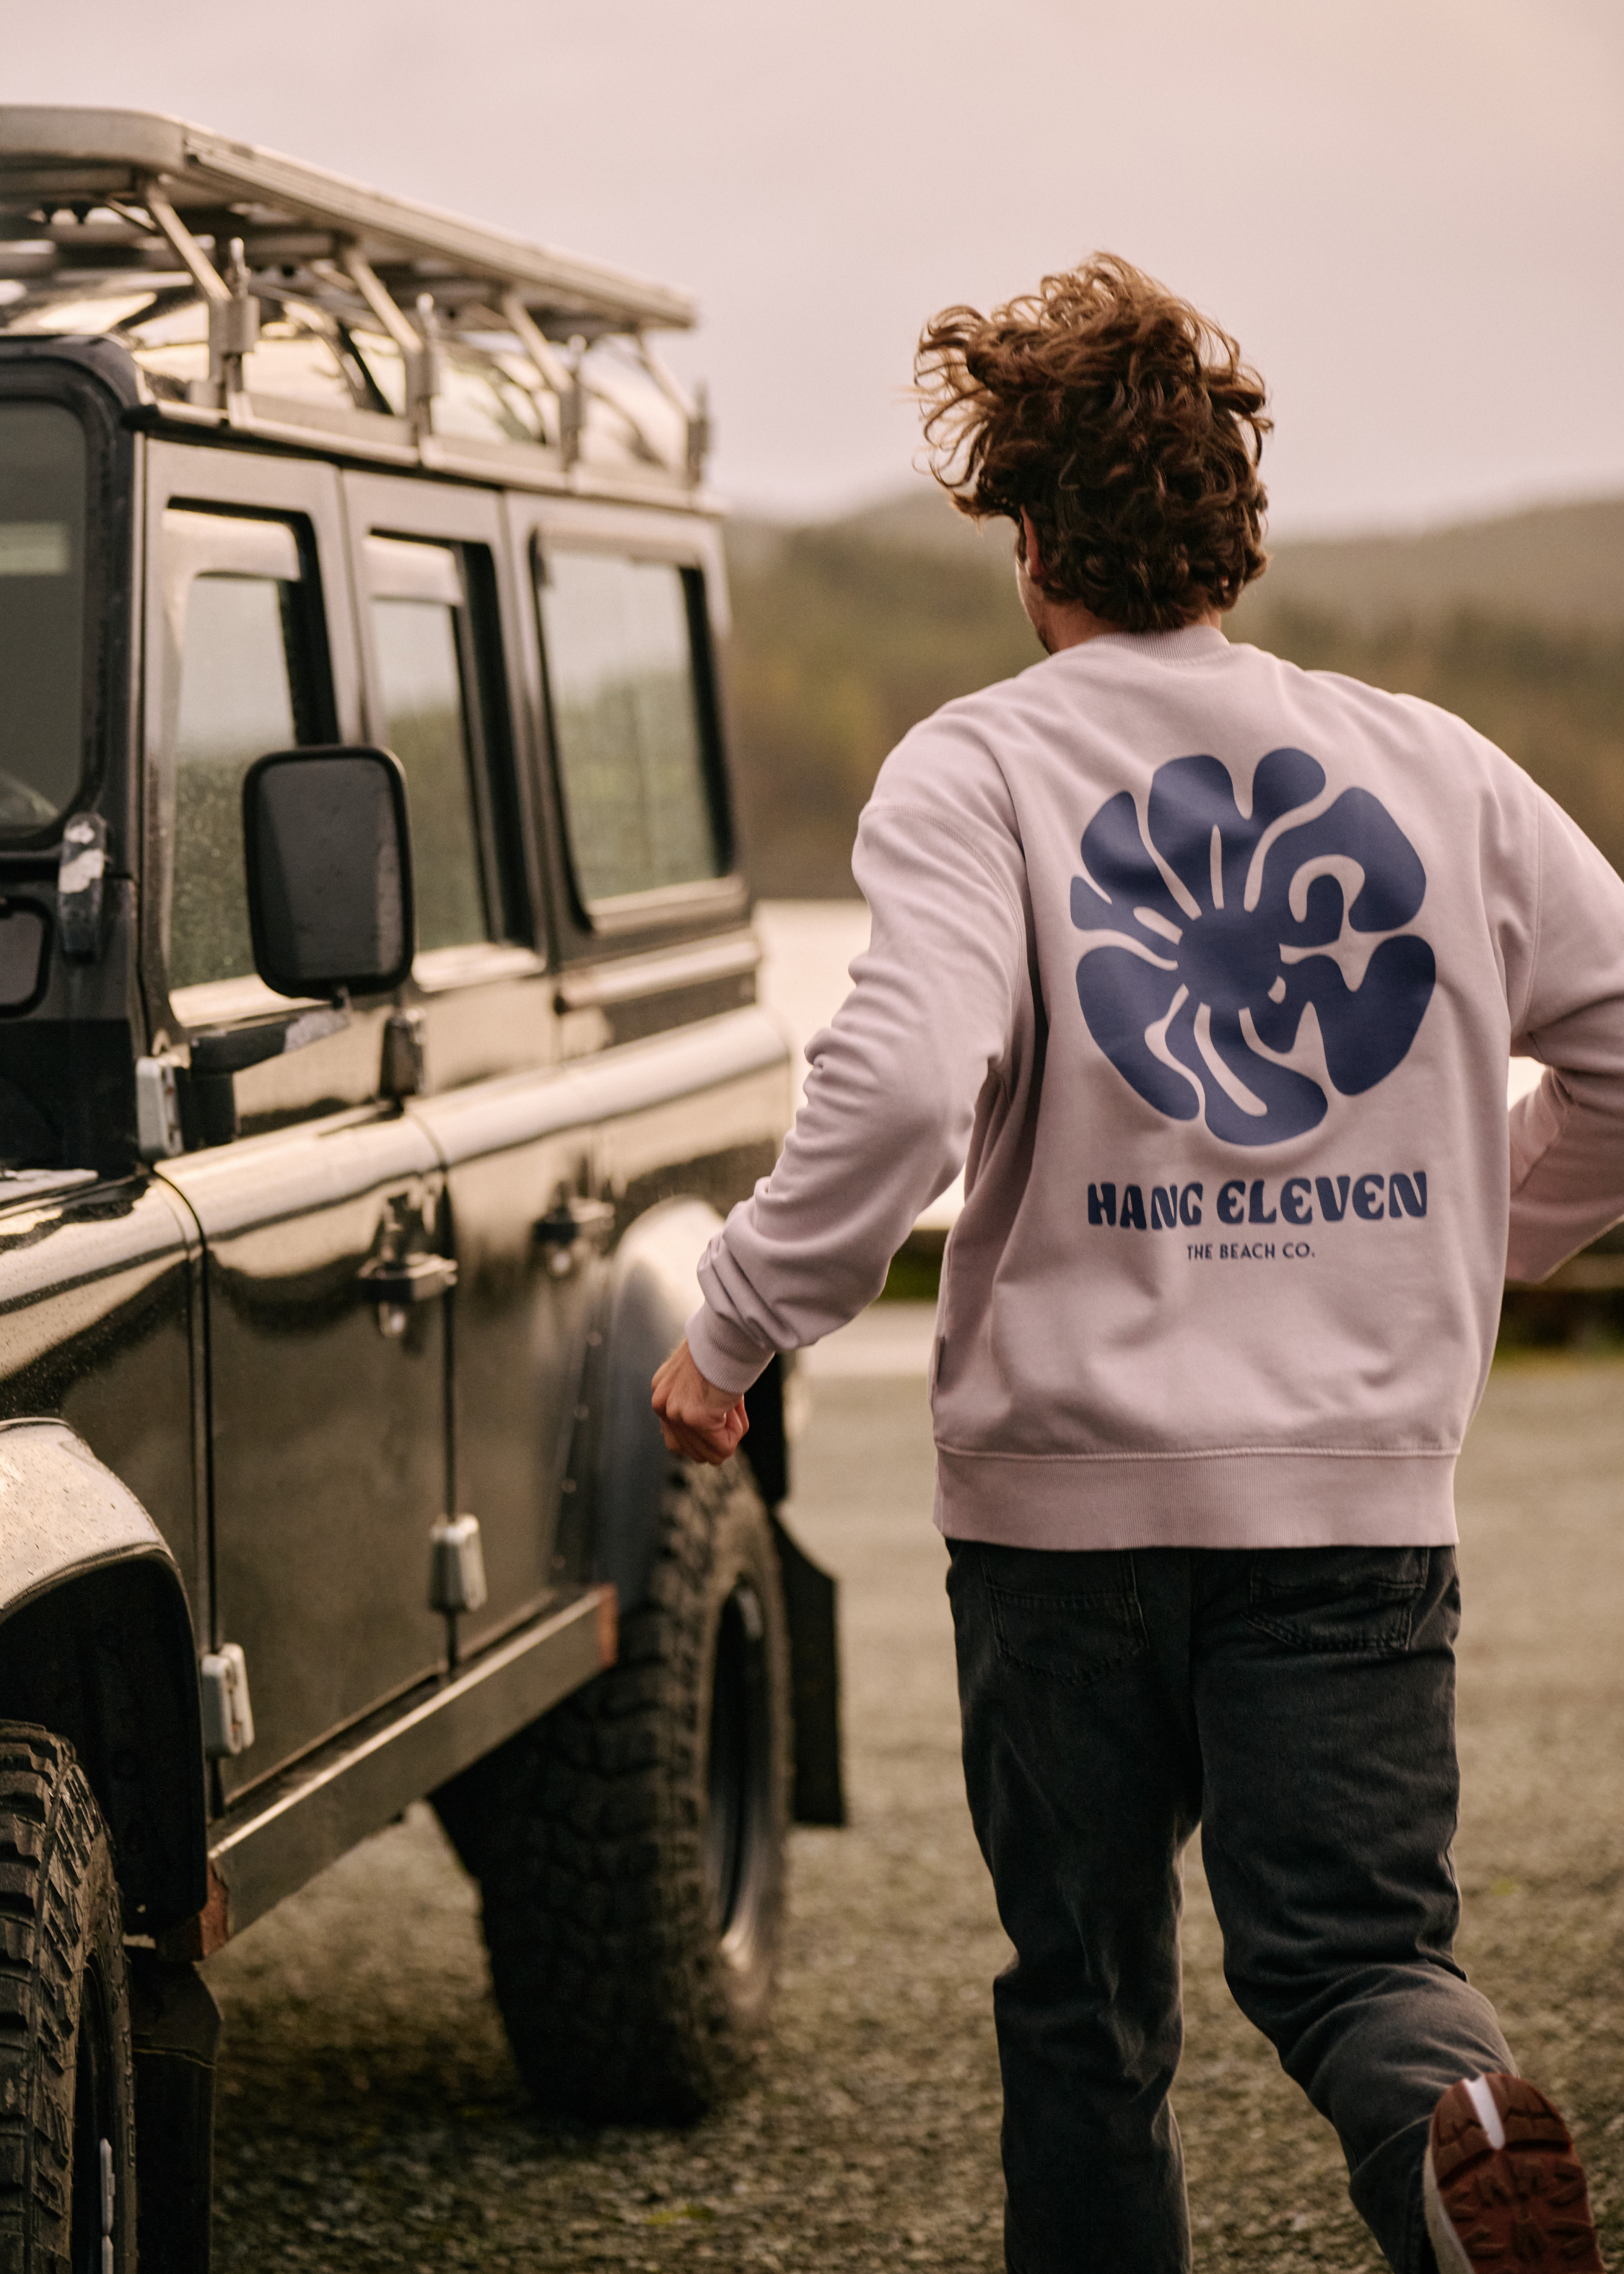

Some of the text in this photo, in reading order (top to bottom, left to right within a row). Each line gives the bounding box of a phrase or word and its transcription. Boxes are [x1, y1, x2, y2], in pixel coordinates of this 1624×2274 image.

[1087, 1170, 1428, 1231] HANG ELEVEN
[1187, 1242, 1316, 1260] THE BEACH CO.
